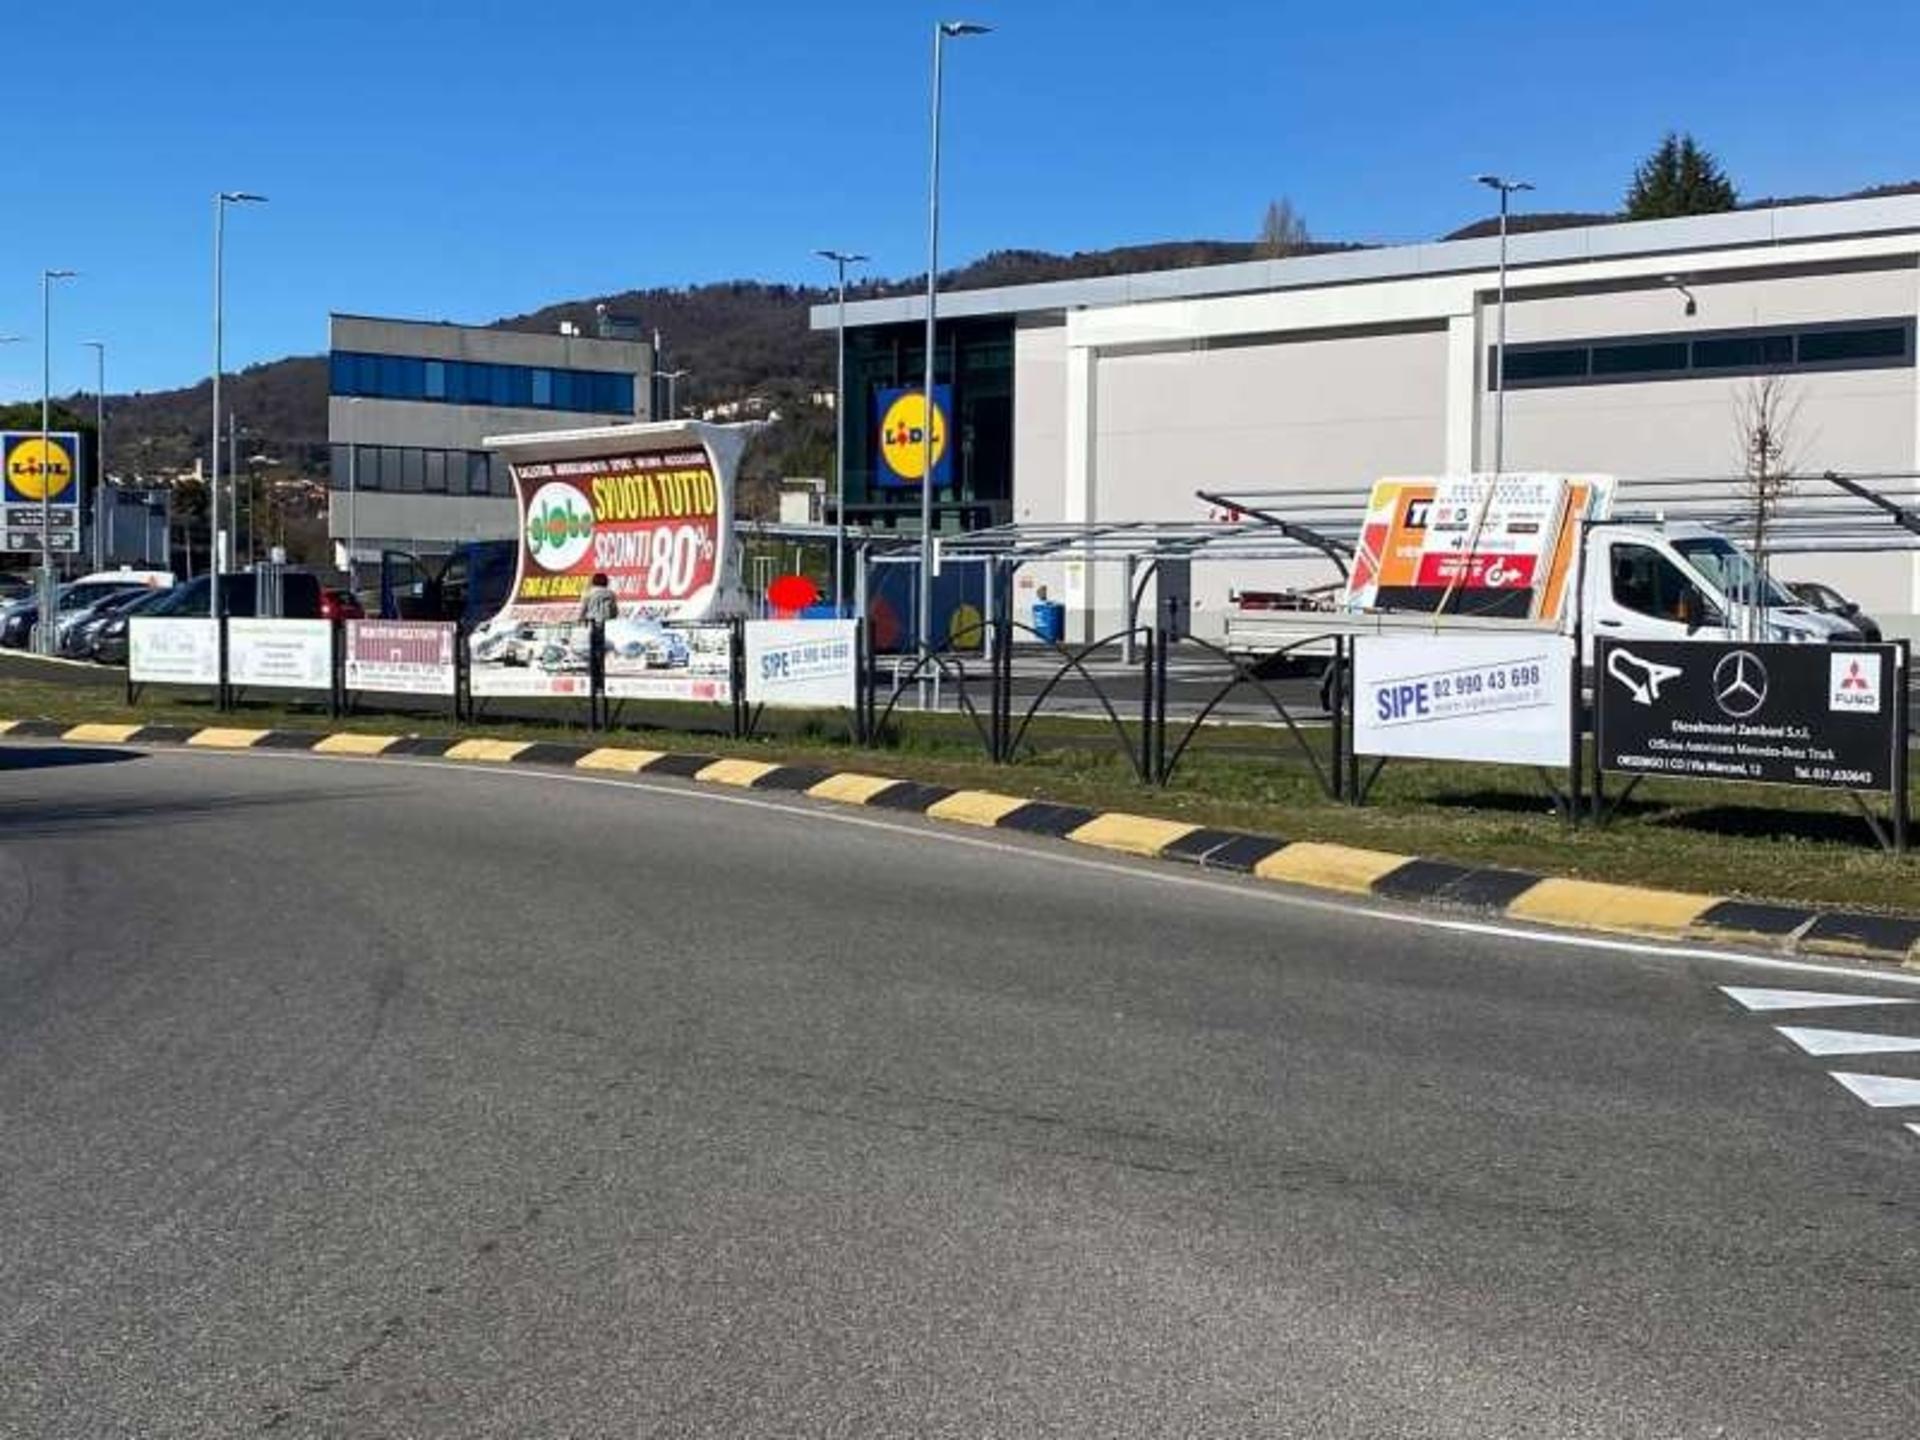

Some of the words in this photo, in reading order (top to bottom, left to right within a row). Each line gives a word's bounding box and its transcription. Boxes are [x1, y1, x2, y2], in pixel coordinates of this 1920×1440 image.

[592, 473, 659, 521] SVUOTA
[656, 469, 716, 519] TUTTO
[594, 531, 650, 569] SCONTI
[761, 652, 790, 680] SIPE
[1378, 684, 1430, 720] SIPE
[1433, 679, 1451, 698] 02
[1487, 671, 1506, 690] 43
[1511, 666, 1540, 687] 698
